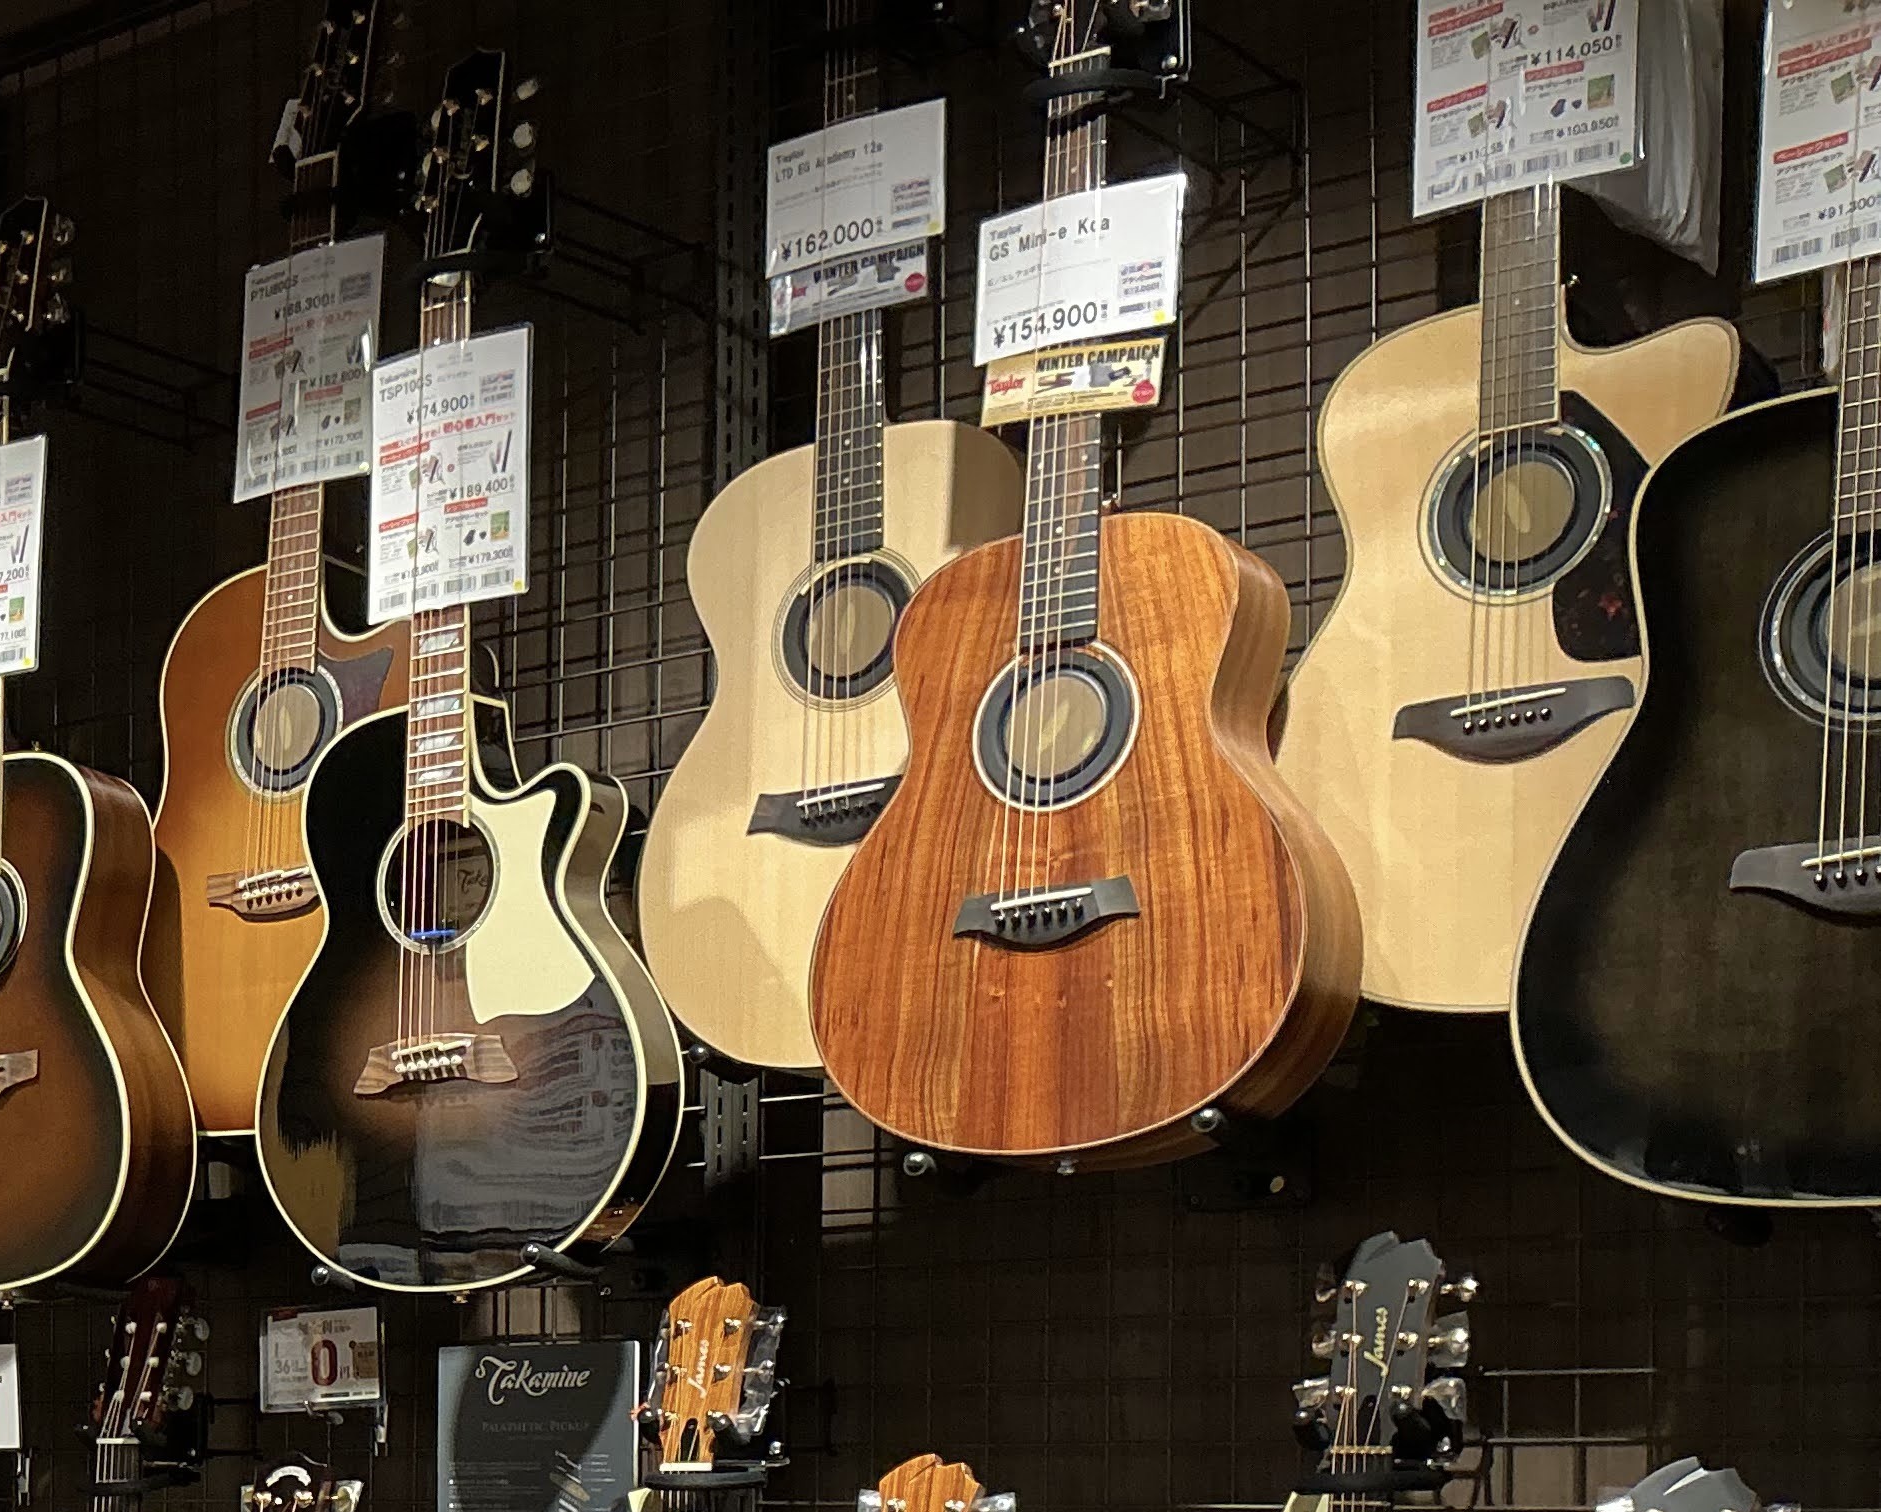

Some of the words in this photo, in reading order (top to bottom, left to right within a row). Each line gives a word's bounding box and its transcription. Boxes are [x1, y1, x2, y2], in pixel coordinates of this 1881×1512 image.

[781, 218, 874, 262] ¥162,000
[989, 242, 1010, 262] GS
[994, 302, 1098, 348] ¥154,900
[1088, 344, 1160, 367] CAMPAIGN
[987, 375, 1026, 395] Taylor
[475, 1355, 591, 1405] Takamine
